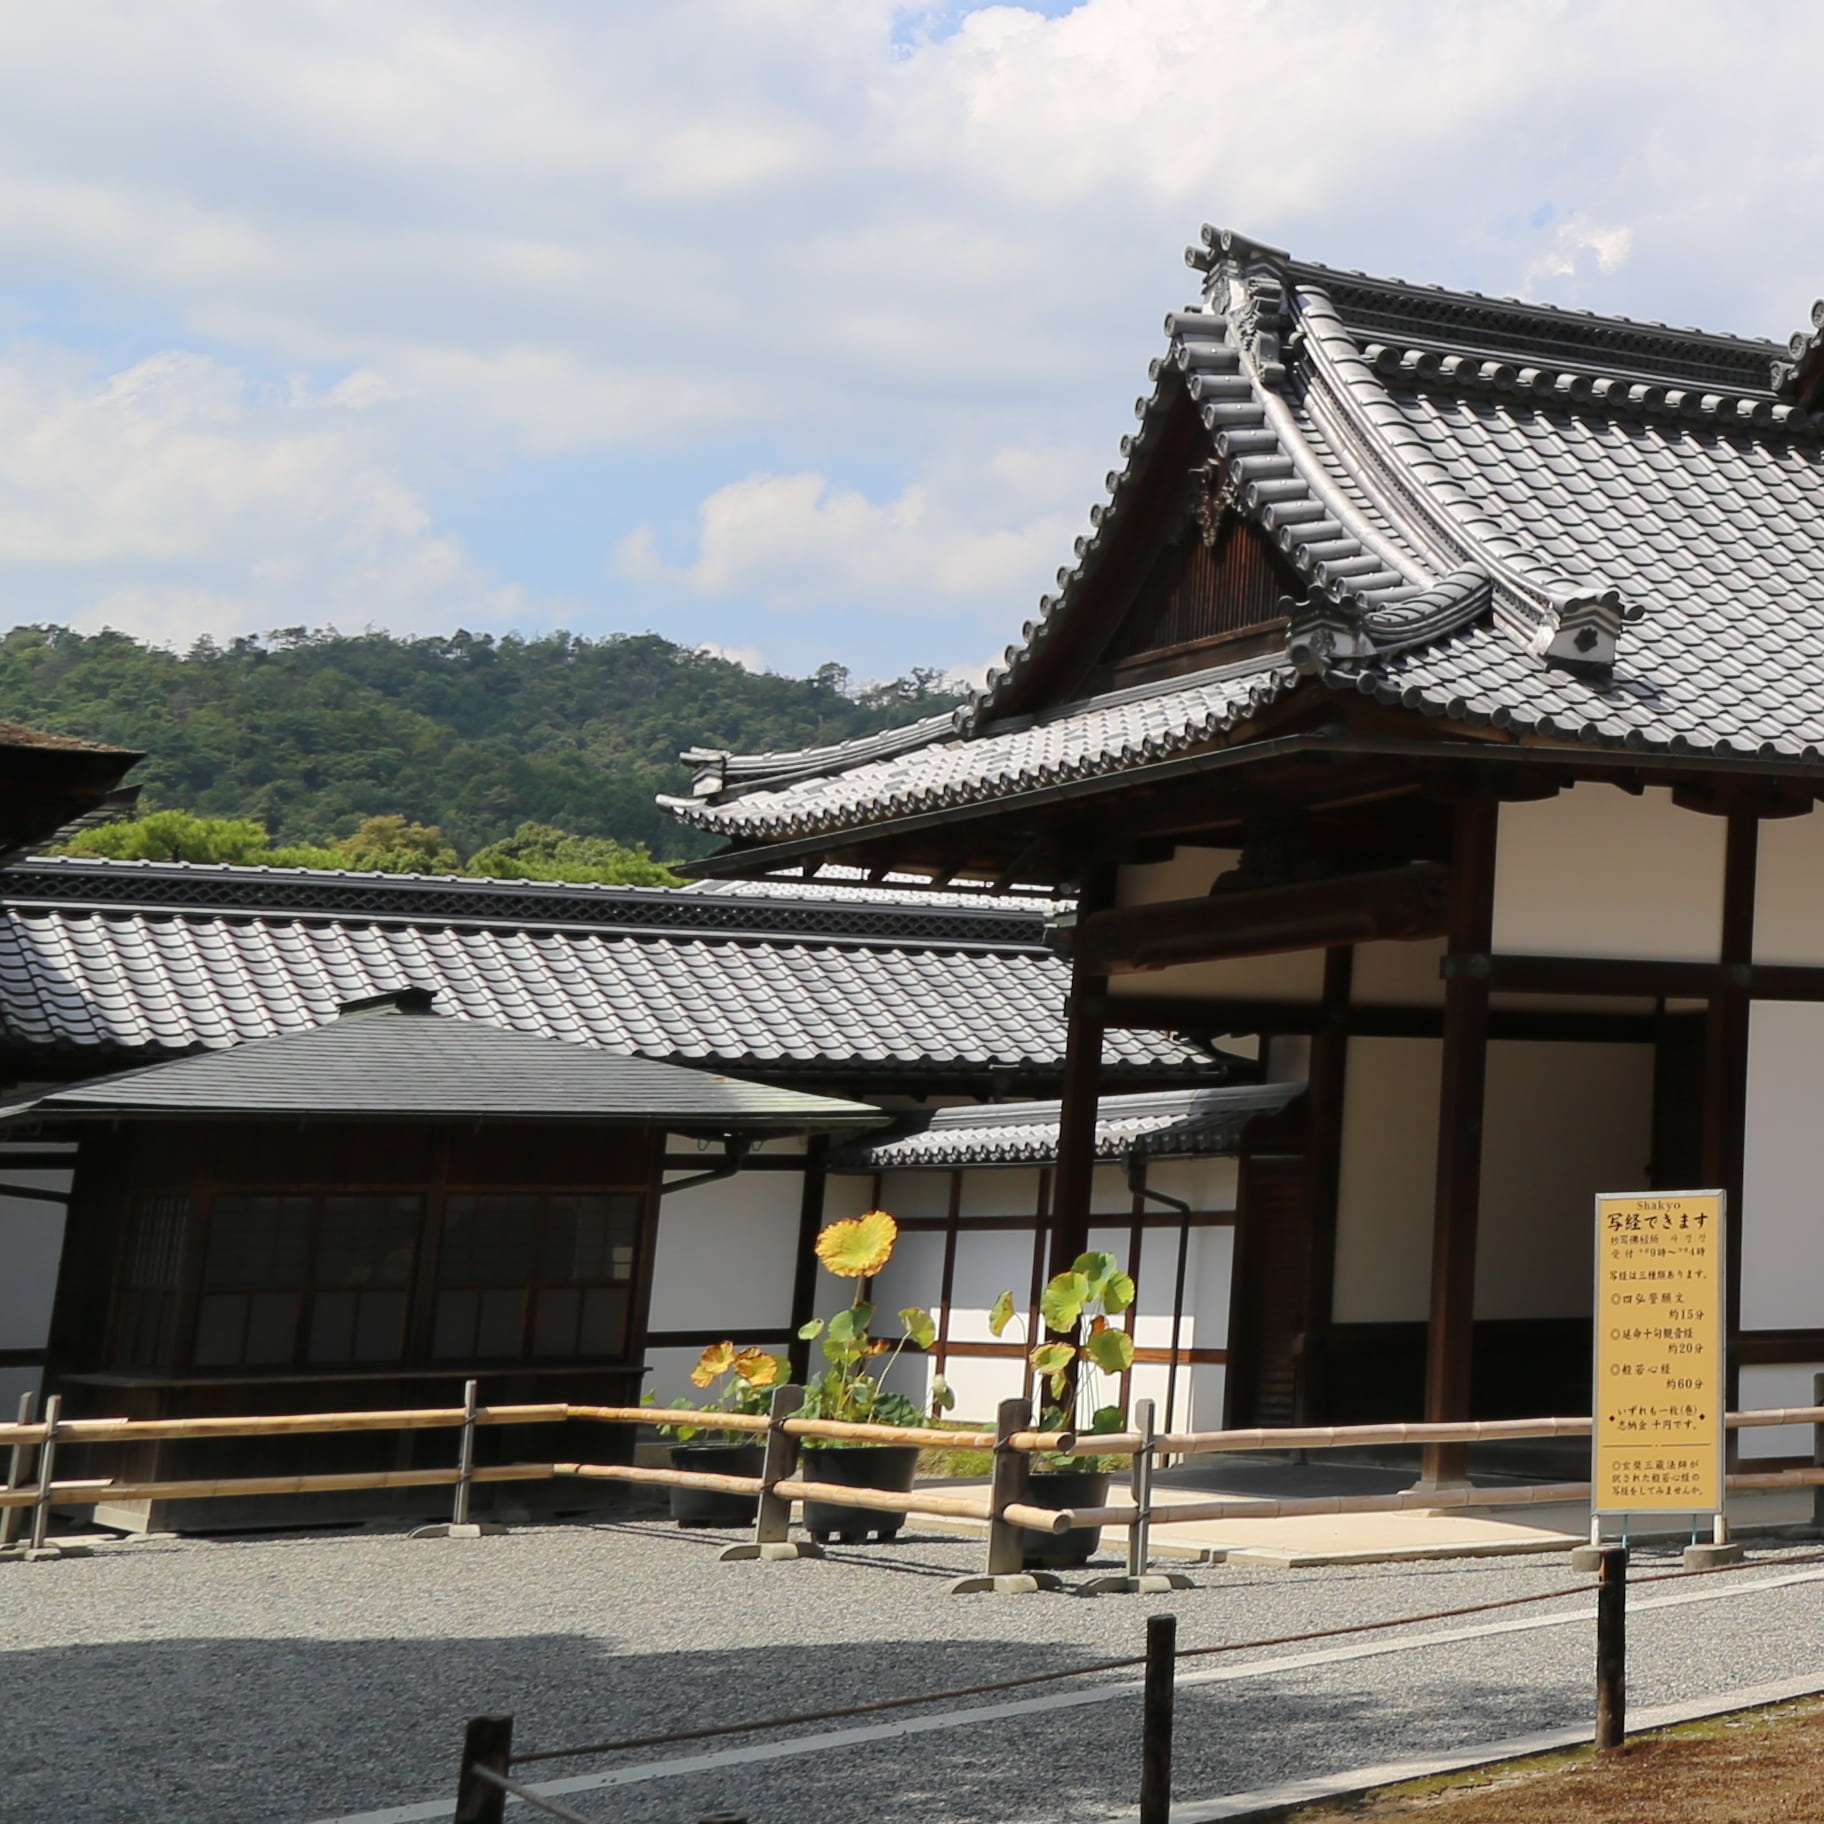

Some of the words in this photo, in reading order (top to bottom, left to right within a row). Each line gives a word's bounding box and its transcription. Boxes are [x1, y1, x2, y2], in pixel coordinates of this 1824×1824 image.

[1636, 1200, 1681, 1212] Shakyo
[1607, 1212, 1708, 1232] 写経できます
[1669, 1309, 1705, 1321] 約15分
[1668, 1343, 1704, 1355] 約20分
[1666, 1378, 1704, 1391] 約60分
